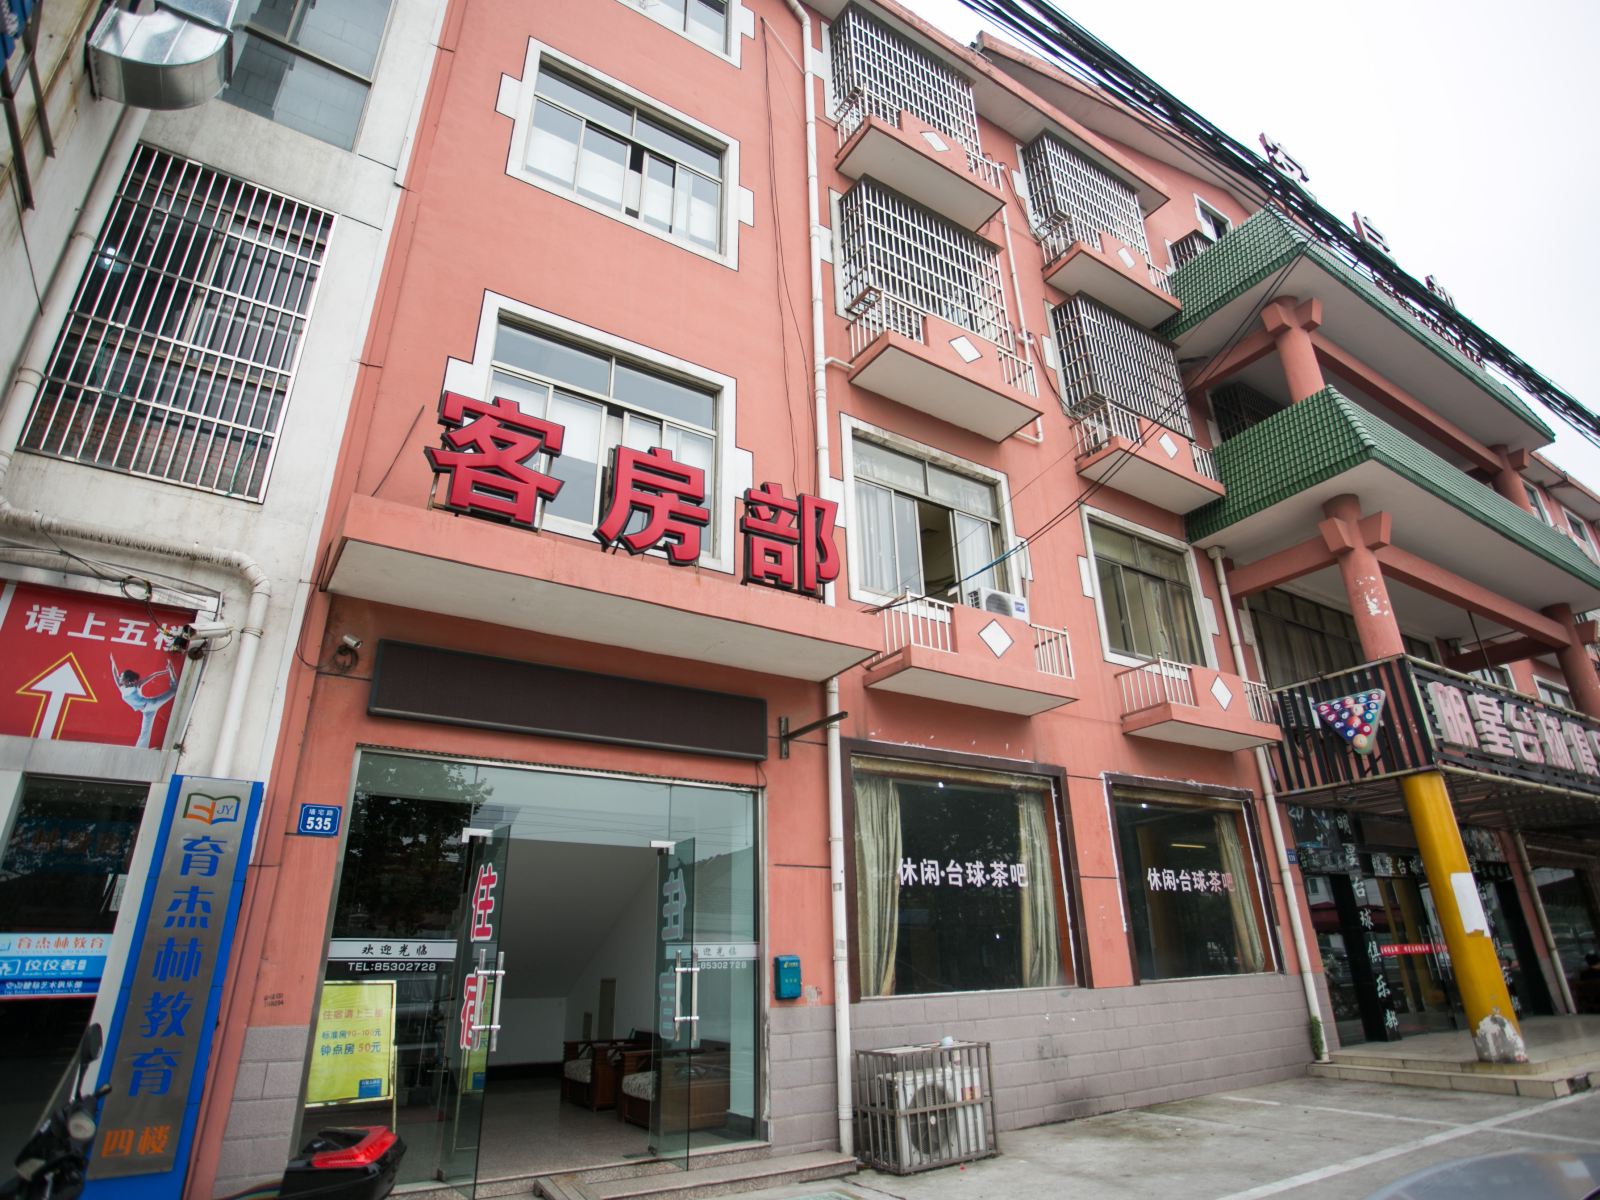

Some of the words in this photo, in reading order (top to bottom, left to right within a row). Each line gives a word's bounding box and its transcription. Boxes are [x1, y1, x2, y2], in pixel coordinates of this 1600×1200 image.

[424, 391, 839, 594] 客房部
[306, 817, 332, 830] 535
[1371, 855, 1424, 875] 明星台球
[361, 944, 428, 957] 欢迎光临
[128, 834, 228, 1097] 育杰林教育
[348, 962, 437, 973] TEL:85302728
[321, 1043, 355, 1056] 钟点房
[358, 1041, 382, 1053] 50元
[100, 1124, 173, 1159] 四楼
